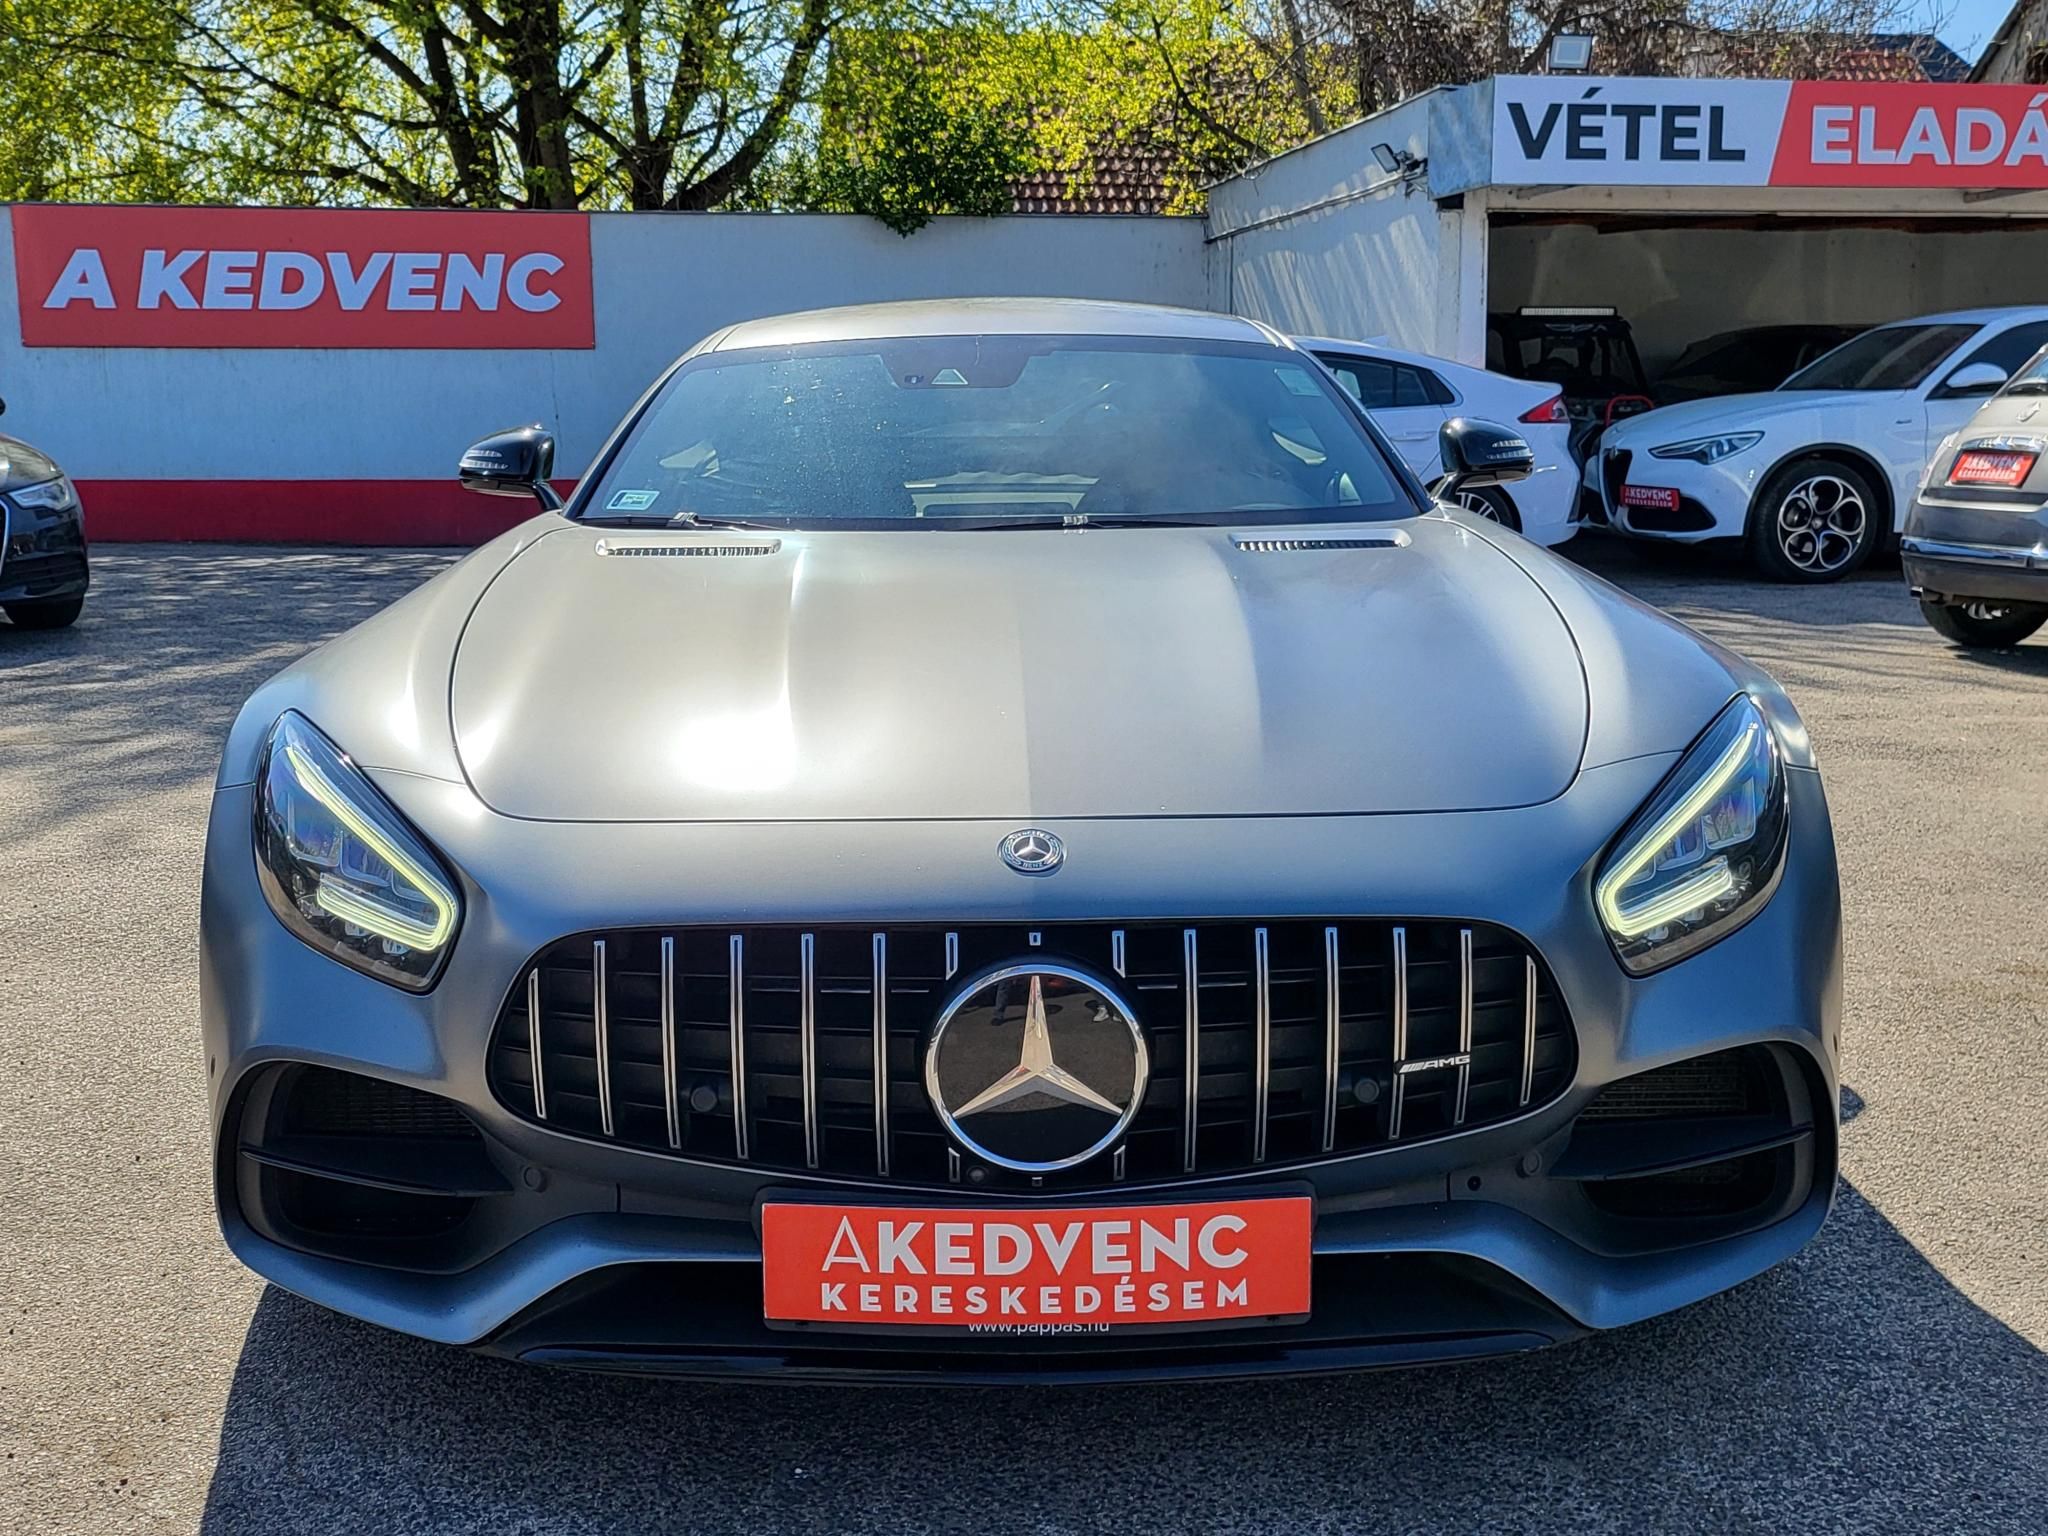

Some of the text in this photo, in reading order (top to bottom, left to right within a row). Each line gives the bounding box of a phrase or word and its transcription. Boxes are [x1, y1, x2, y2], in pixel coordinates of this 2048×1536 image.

[1507, 87, 1746, 161] VÉTEL
[1811, 92, 2048, 167] ELADÁ
[43, 249, 565, 312] A KEDVENC
[821, 1276, 1249, 1315] KERESKEDÉSEM
